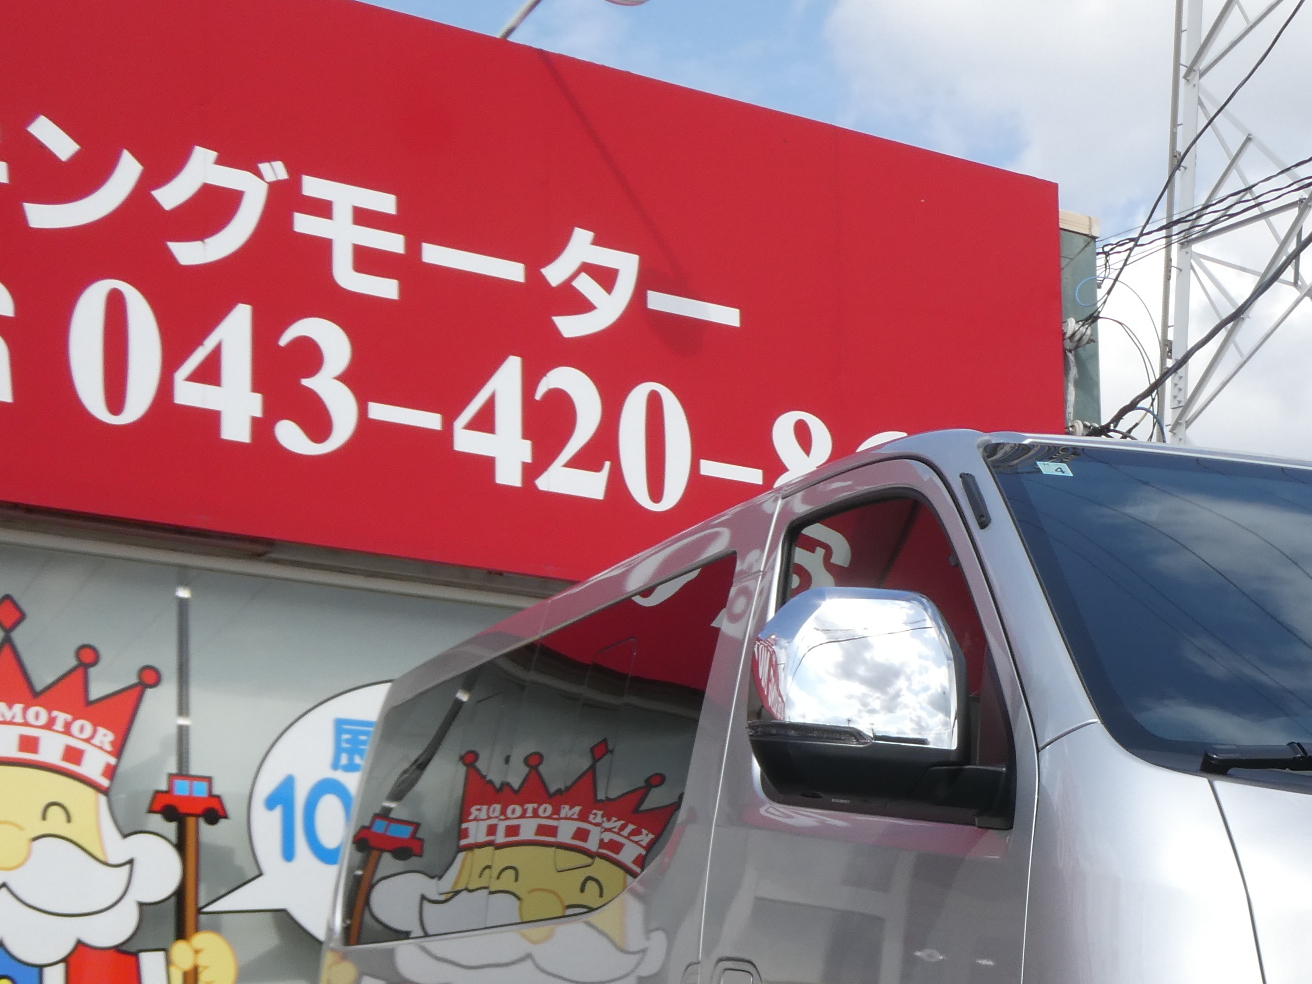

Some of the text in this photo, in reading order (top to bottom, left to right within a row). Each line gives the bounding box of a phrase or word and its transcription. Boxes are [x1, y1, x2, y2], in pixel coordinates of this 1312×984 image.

[0, 115, 741, 338] ングモーター
[67, 278, 908, 512] 043-420-8
[0, 701, 116, 752] MOTOR
